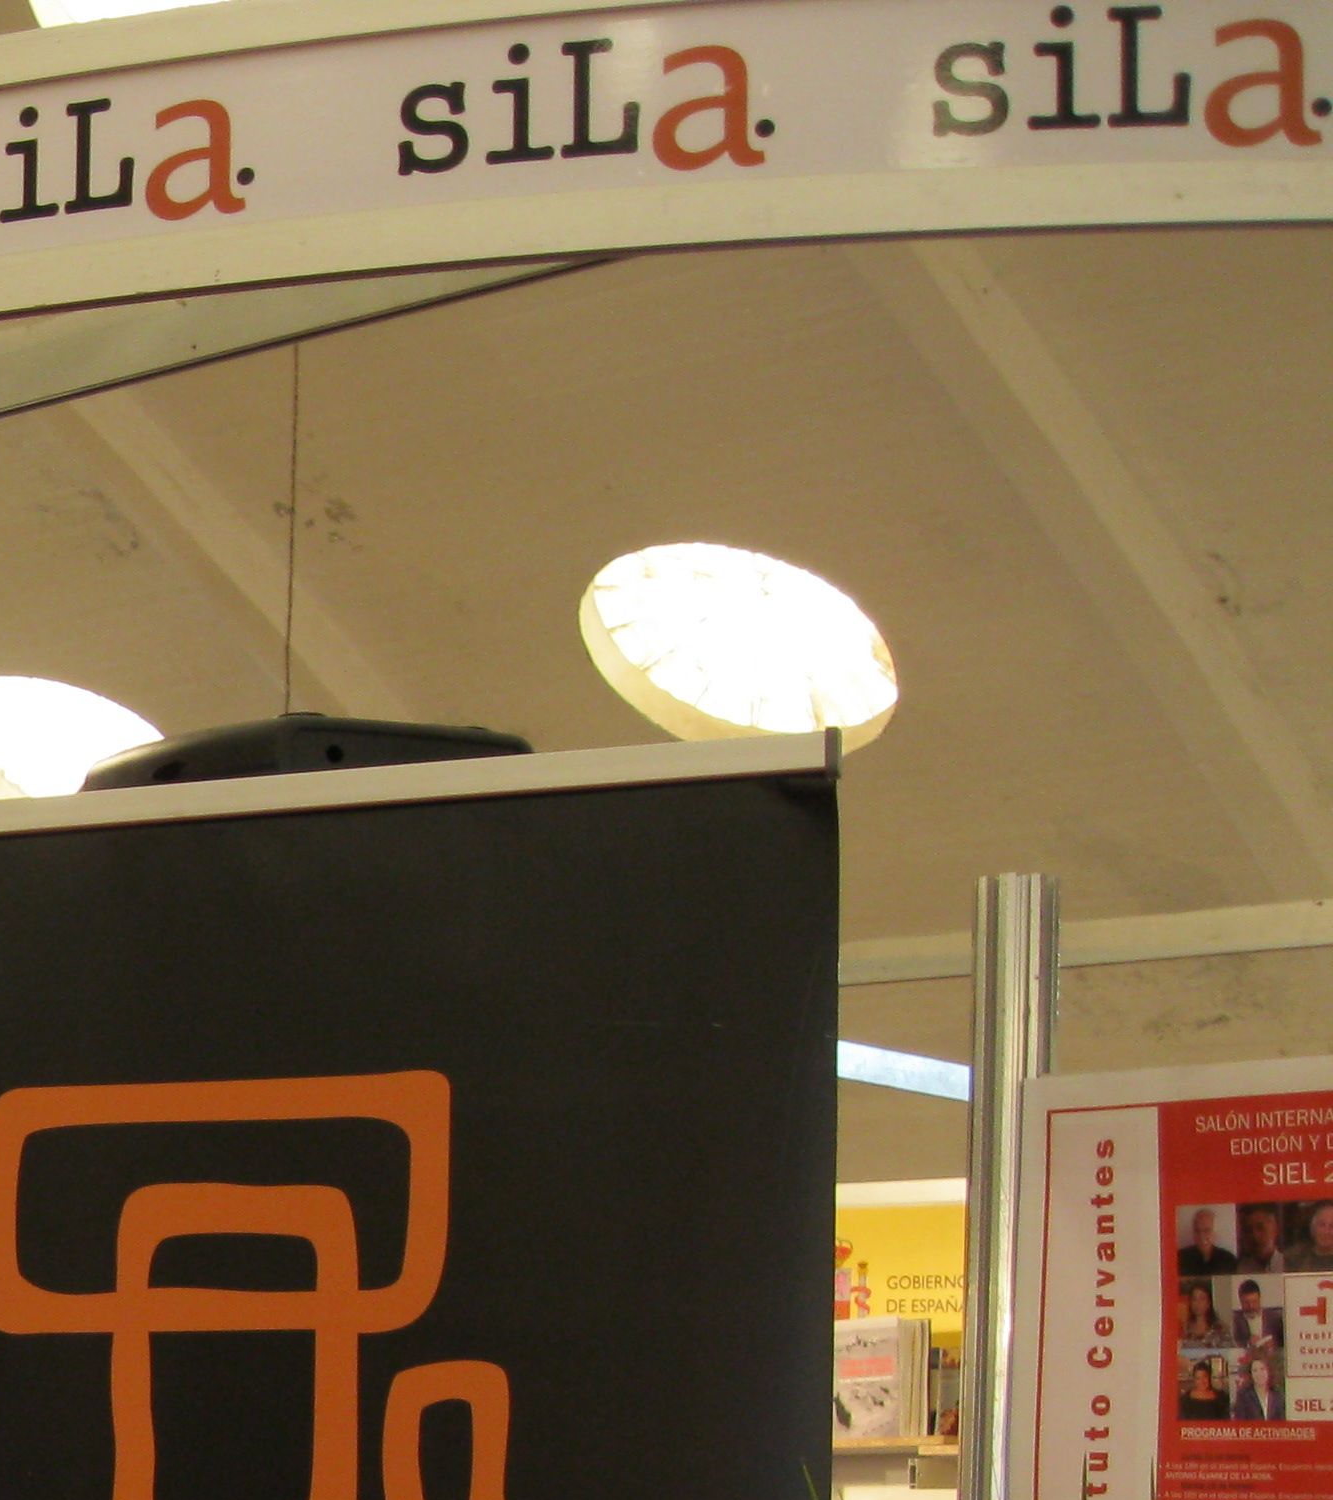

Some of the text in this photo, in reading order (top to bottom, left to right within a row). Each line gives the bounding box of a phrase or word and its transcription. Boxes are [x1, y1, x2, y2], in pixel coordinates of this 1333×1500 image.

[1195, 1110, 1250, 1133] SALÓN
[1230, 1132, 1302, 1156] EDICIÓN
[1308, 1134, 1320, 1151] Y
[1262, 1162, 1316, 1186] SIEL
[1086, 1138, 1116, 1370] Cervantes
[886, 1299, 908, 1313] DE
